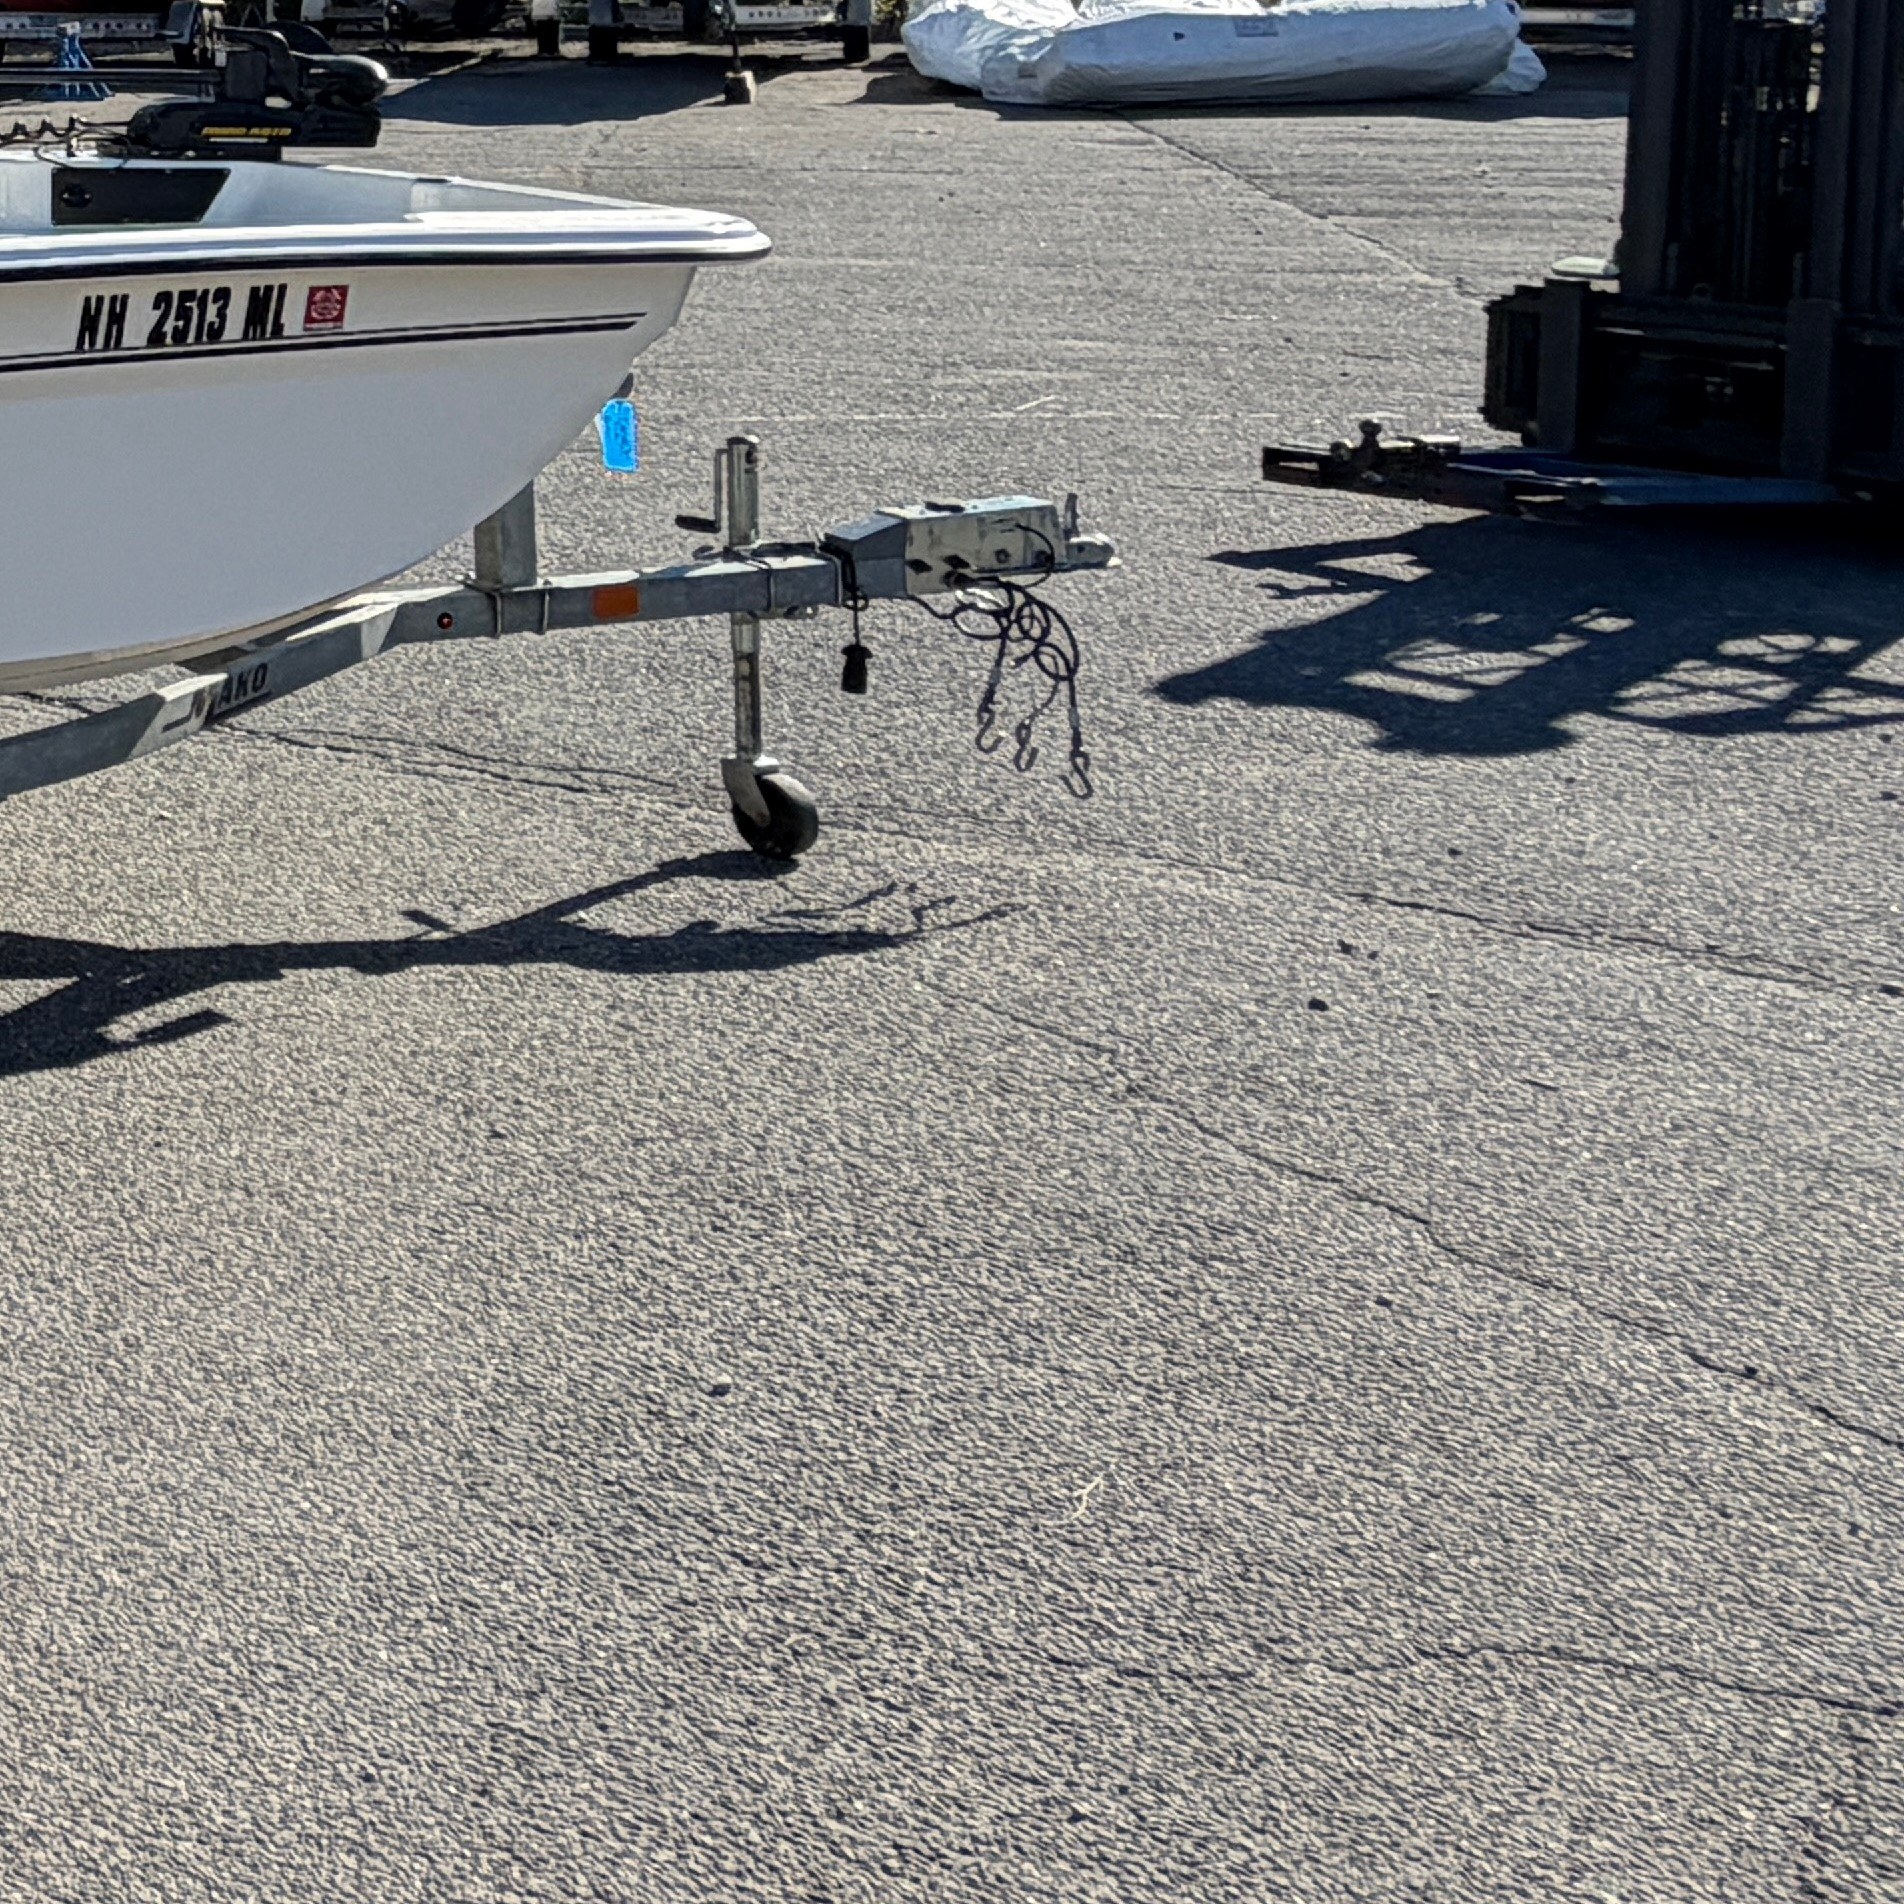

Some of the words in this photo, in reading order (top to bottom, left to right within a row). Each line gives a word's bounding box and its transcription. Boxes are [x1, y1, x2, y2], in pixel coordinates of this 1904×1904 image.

[75, 293, 129, 352] NH
[147, 286, 232, 346] 2513
[242, 283, 288, 341] ML
[162, 662, 273, 733] MAKO
